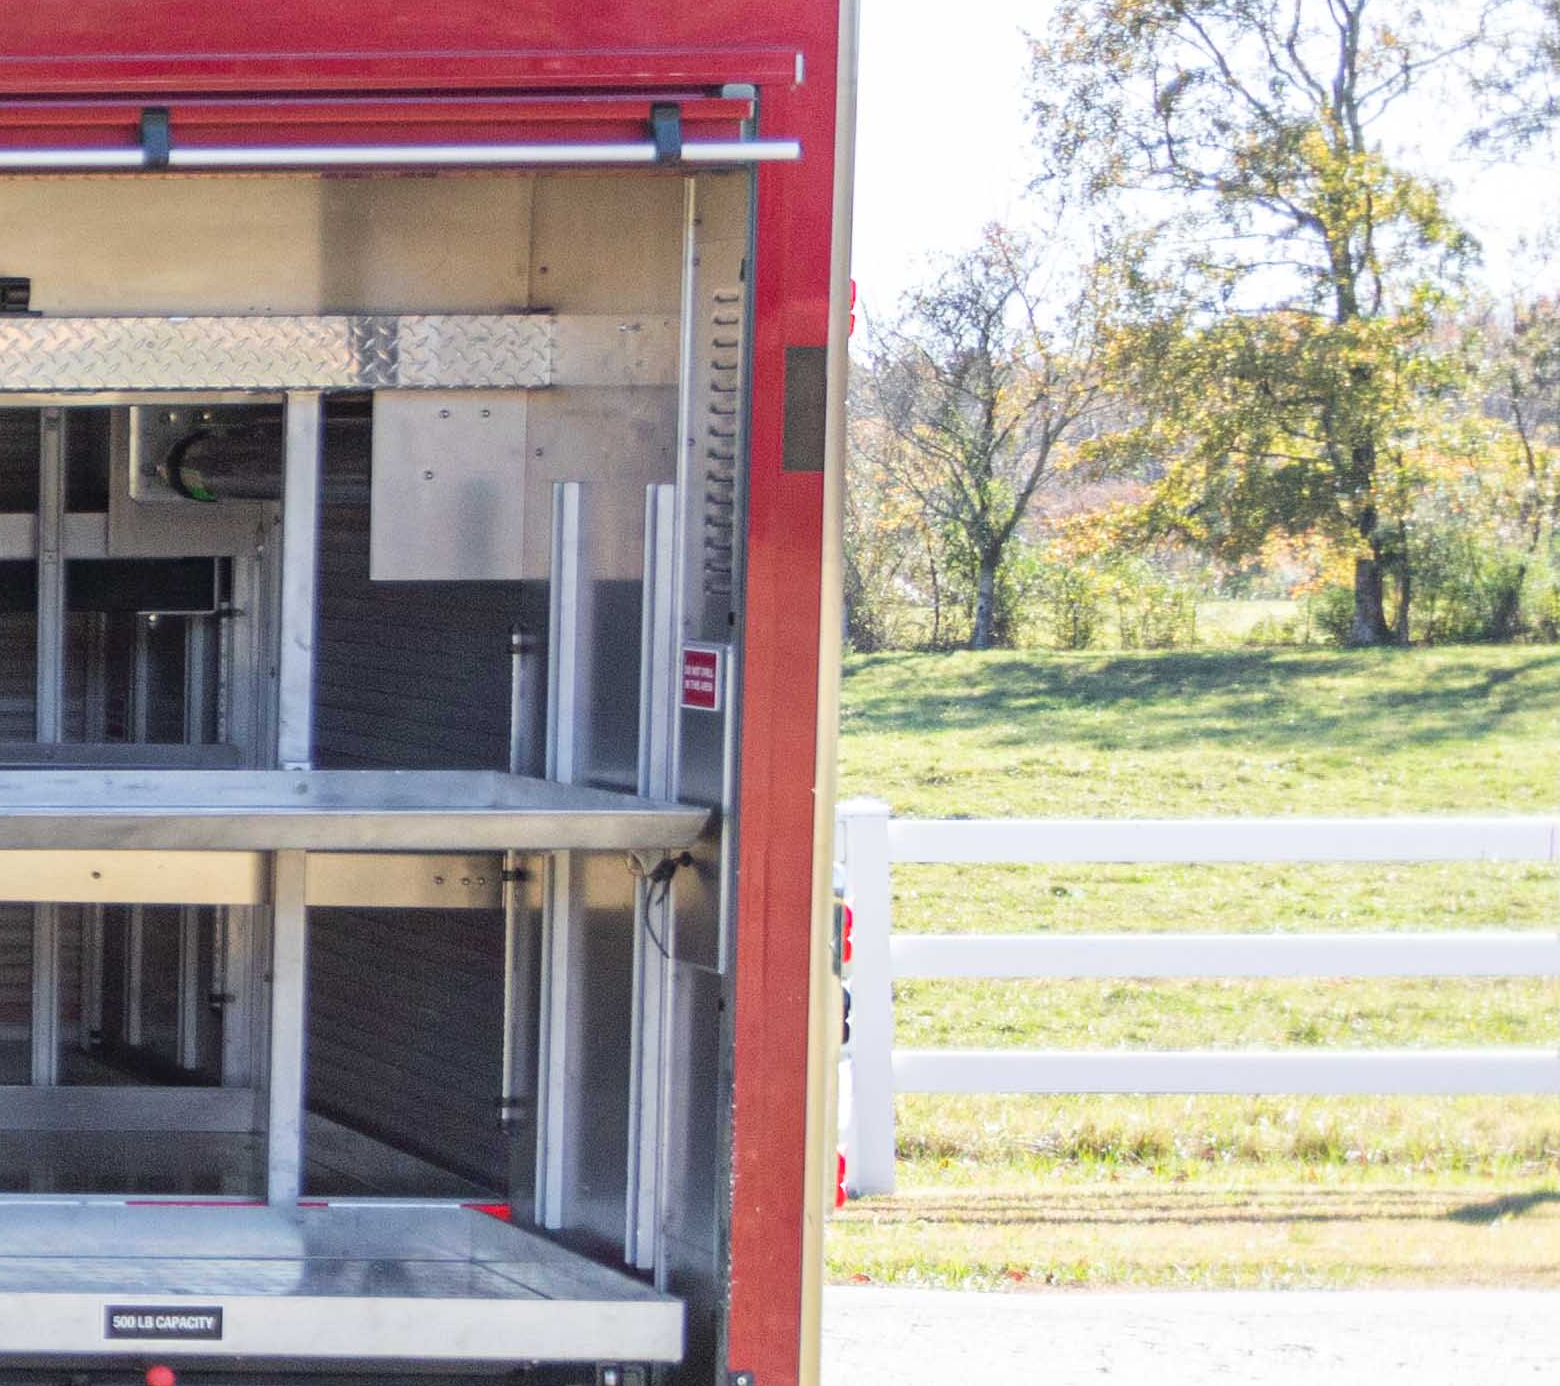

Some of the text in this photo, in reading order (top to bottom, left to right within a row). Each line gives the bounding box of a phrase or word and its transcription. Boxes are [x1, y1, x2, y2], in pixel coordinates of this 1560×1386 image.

[112, 1315, 215, 1330] 500 LB CAPACITY
